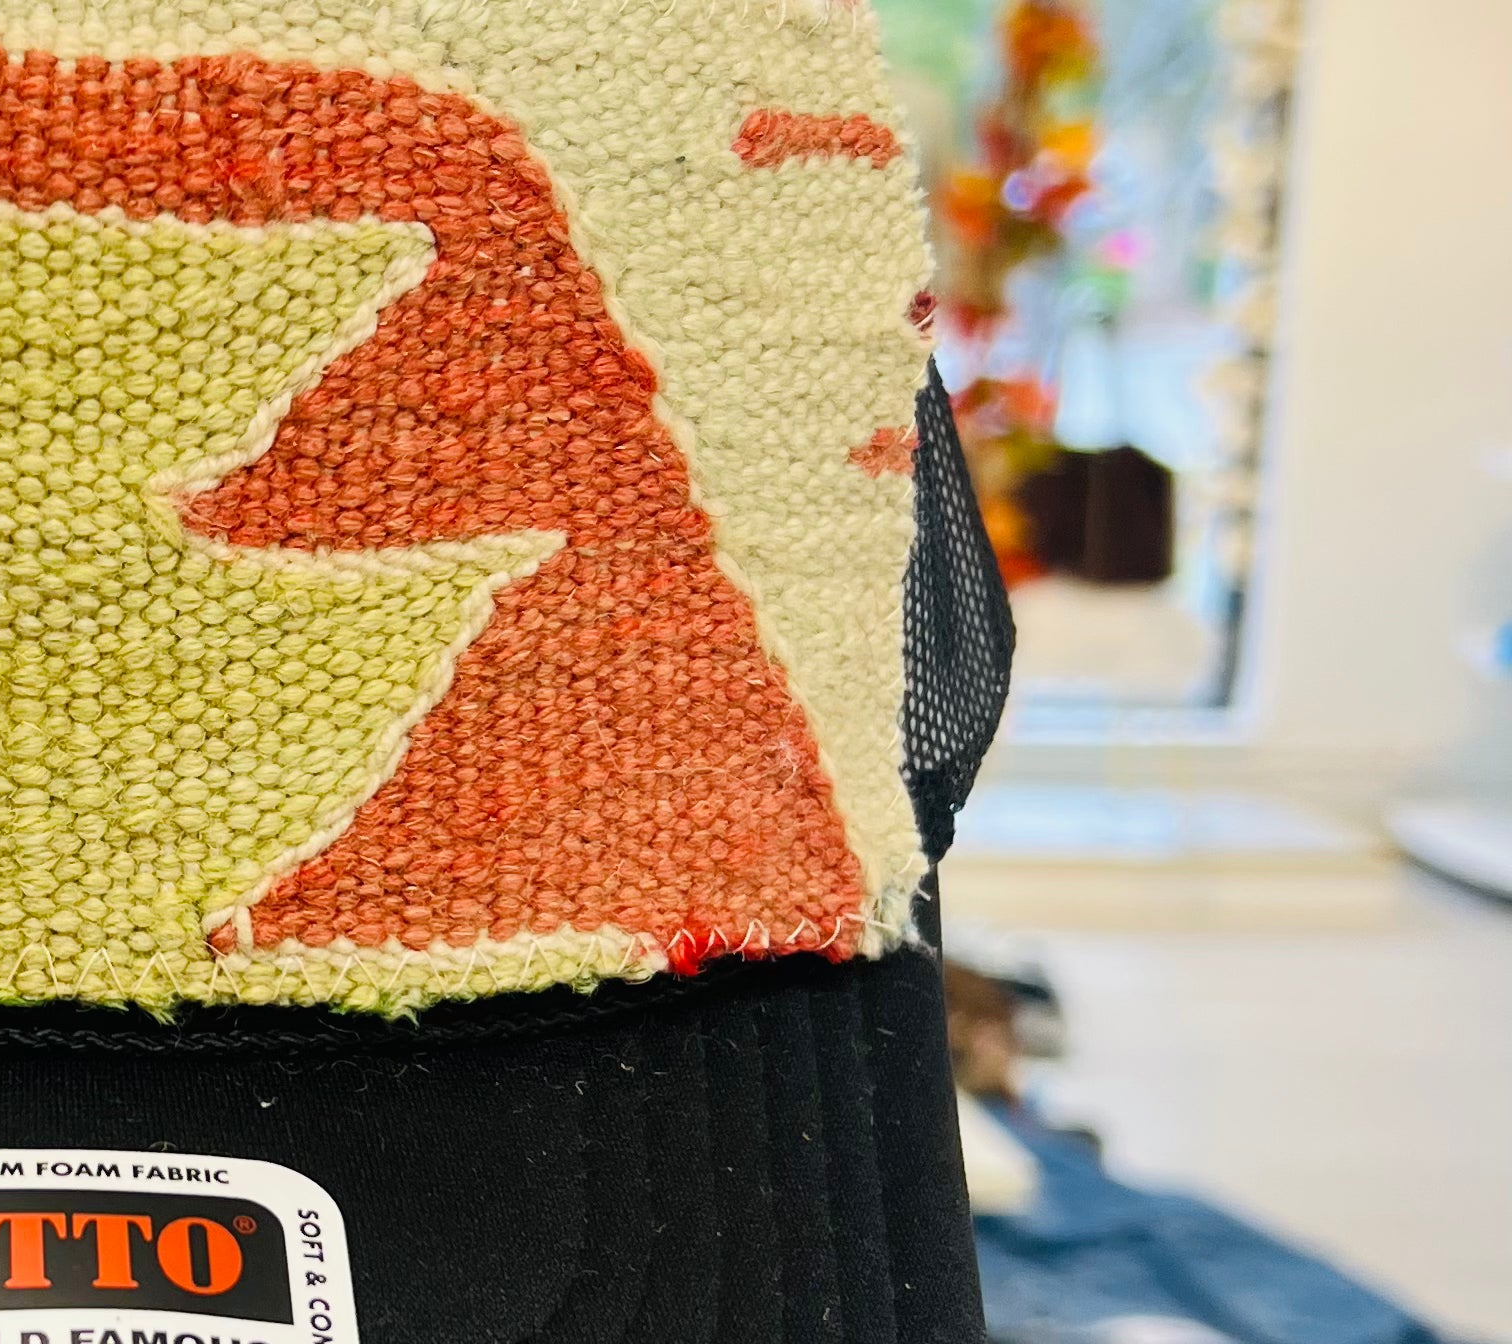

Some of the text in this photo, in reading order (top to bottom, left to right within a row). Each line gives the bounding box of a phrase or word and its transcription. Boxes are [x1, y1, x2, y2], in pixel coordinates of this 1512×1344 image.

[36, 1162, 121, 1178] FOAM
[132, 1164, 230, 1185] FABRIC
[297, 1209, 324, 1264] SOFT
[305, 1270, 322, 1287] &
